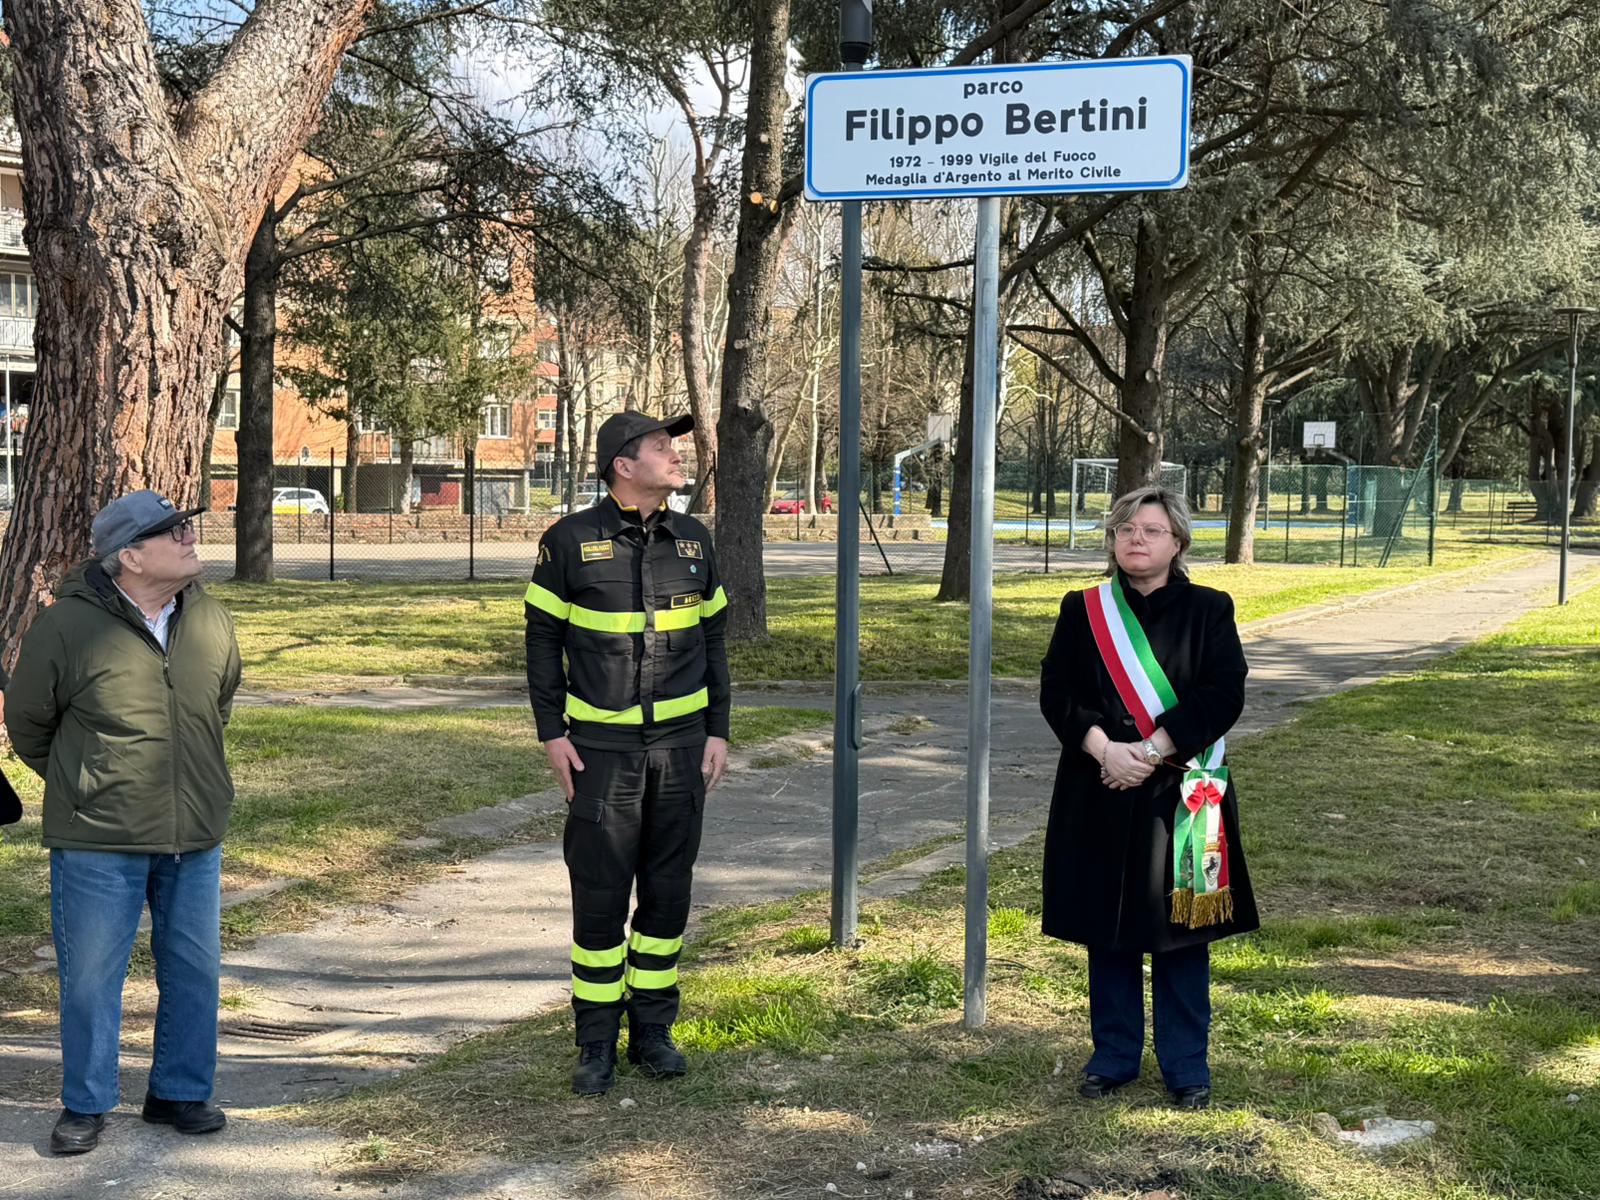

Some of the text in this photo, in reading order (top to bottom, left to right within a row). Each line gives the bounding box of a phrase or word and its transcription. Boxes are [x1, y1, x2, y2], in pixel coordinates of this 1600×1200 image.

[964, 81, 1023, 100] parco
[845, 96, 1148, 146] Filippo Bertini
[889, 155, 922, 168] 1972
[940, 153, 974, 167] 1999
[979, 152, 1019, 167] Vigile
[1024, 151, 1047, 164] del
[1053, 150, 1097, 163] Fuoco
[865, 165, 1121, 187] Medaglia d'Argento al Merito Civile
